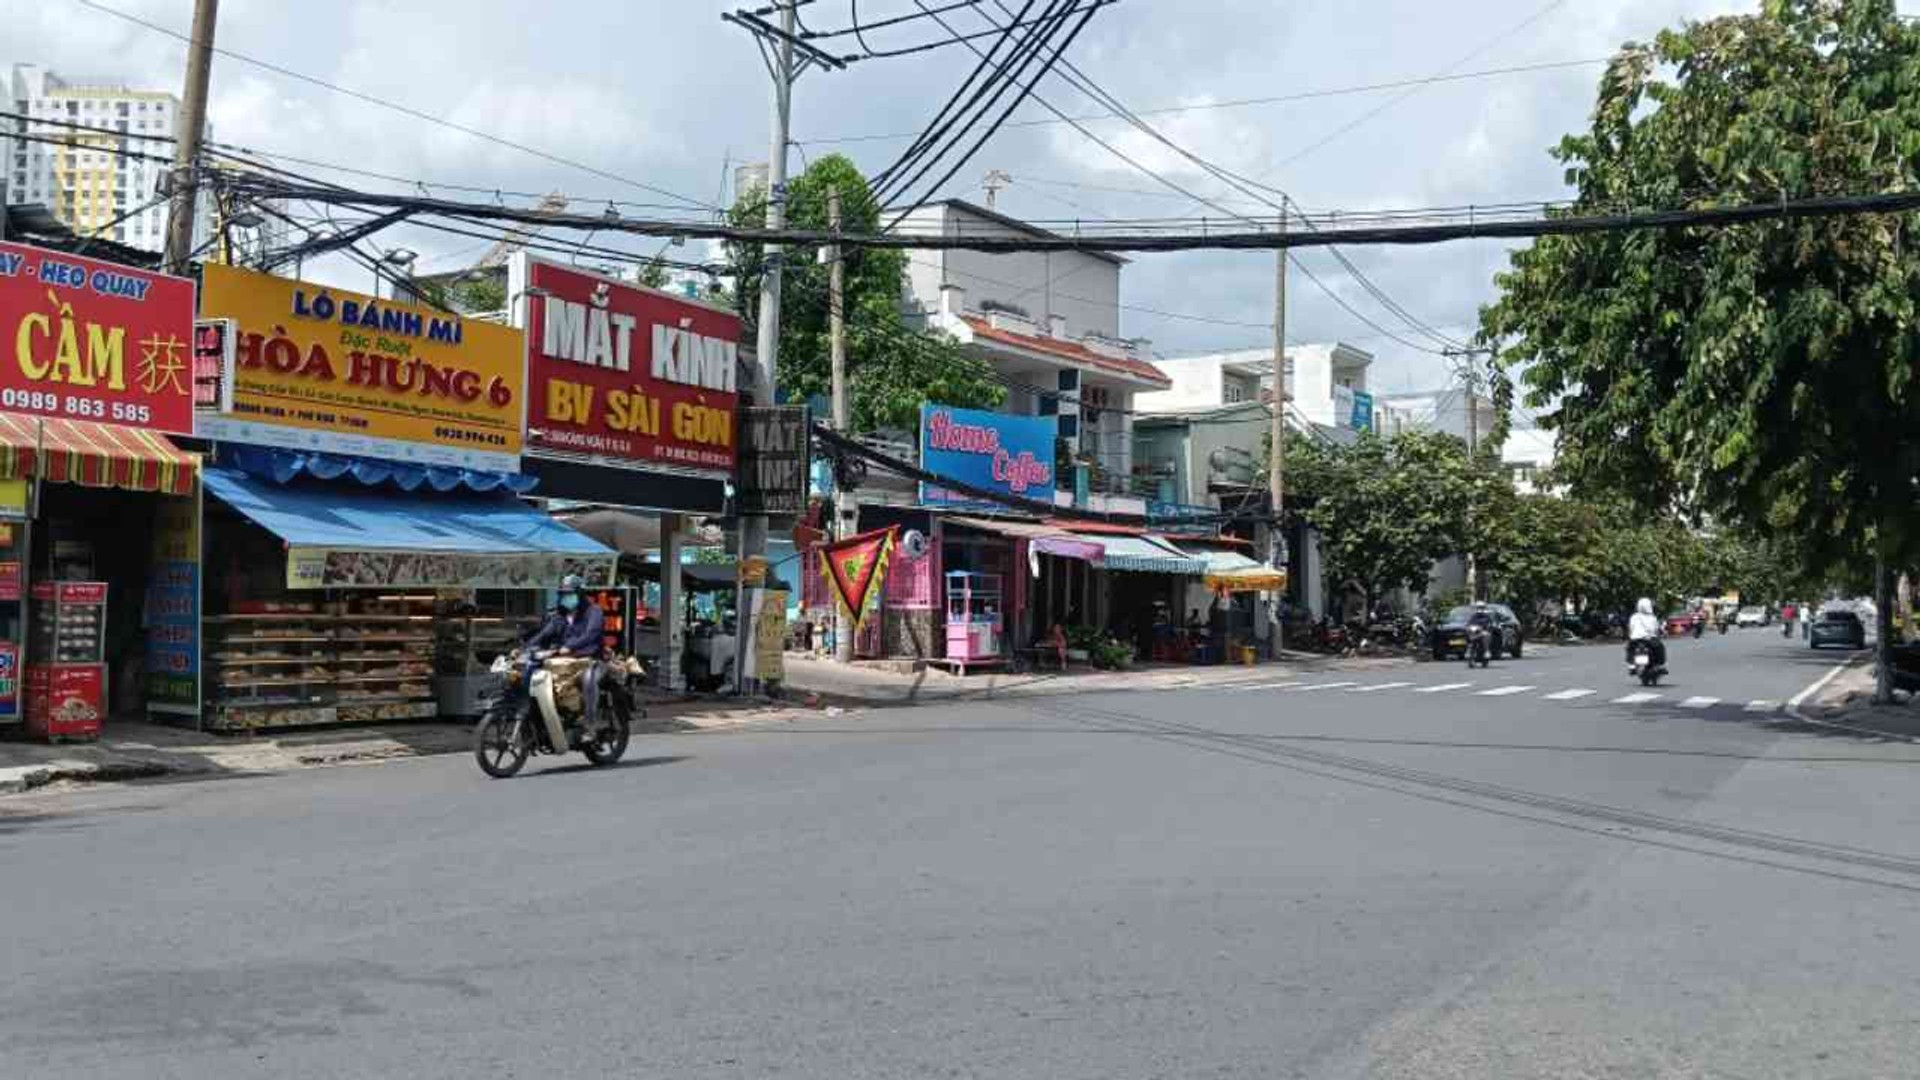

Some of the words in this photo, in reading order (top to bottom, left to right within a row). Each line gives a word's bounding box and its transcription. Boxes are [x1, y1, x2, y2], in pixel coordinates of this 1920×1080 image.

[39, 261, 86, 287] HEO
[91, 272, 151, 300] QUAY
[16, 289, 125, 389] CẦM
[293, 289, 335, 319] LÒ
[340, 300, 423, 337] BÁNH
[428, 314, 463, 344] MÌ
[543, 281, 636, 371] MẮT
[651, 318, 737, 393] KÍNH
[237, 324, 336, 382] HÒA
[346, 350, 481, 402] HƯNG
[488, 375, 512, 408] 6
[2, 388, 57, 410] 0989
[65, 397, 105, 417] 863
[112, 403, 150, 422] 585
[546, 377, 595, 425] BV
[605, 384, 661, 436] SÀI
[672, 394, 731, 446] GÒN
[930, 411, 999, 454] Home
[992, 450, 1050, 492] Coffee
